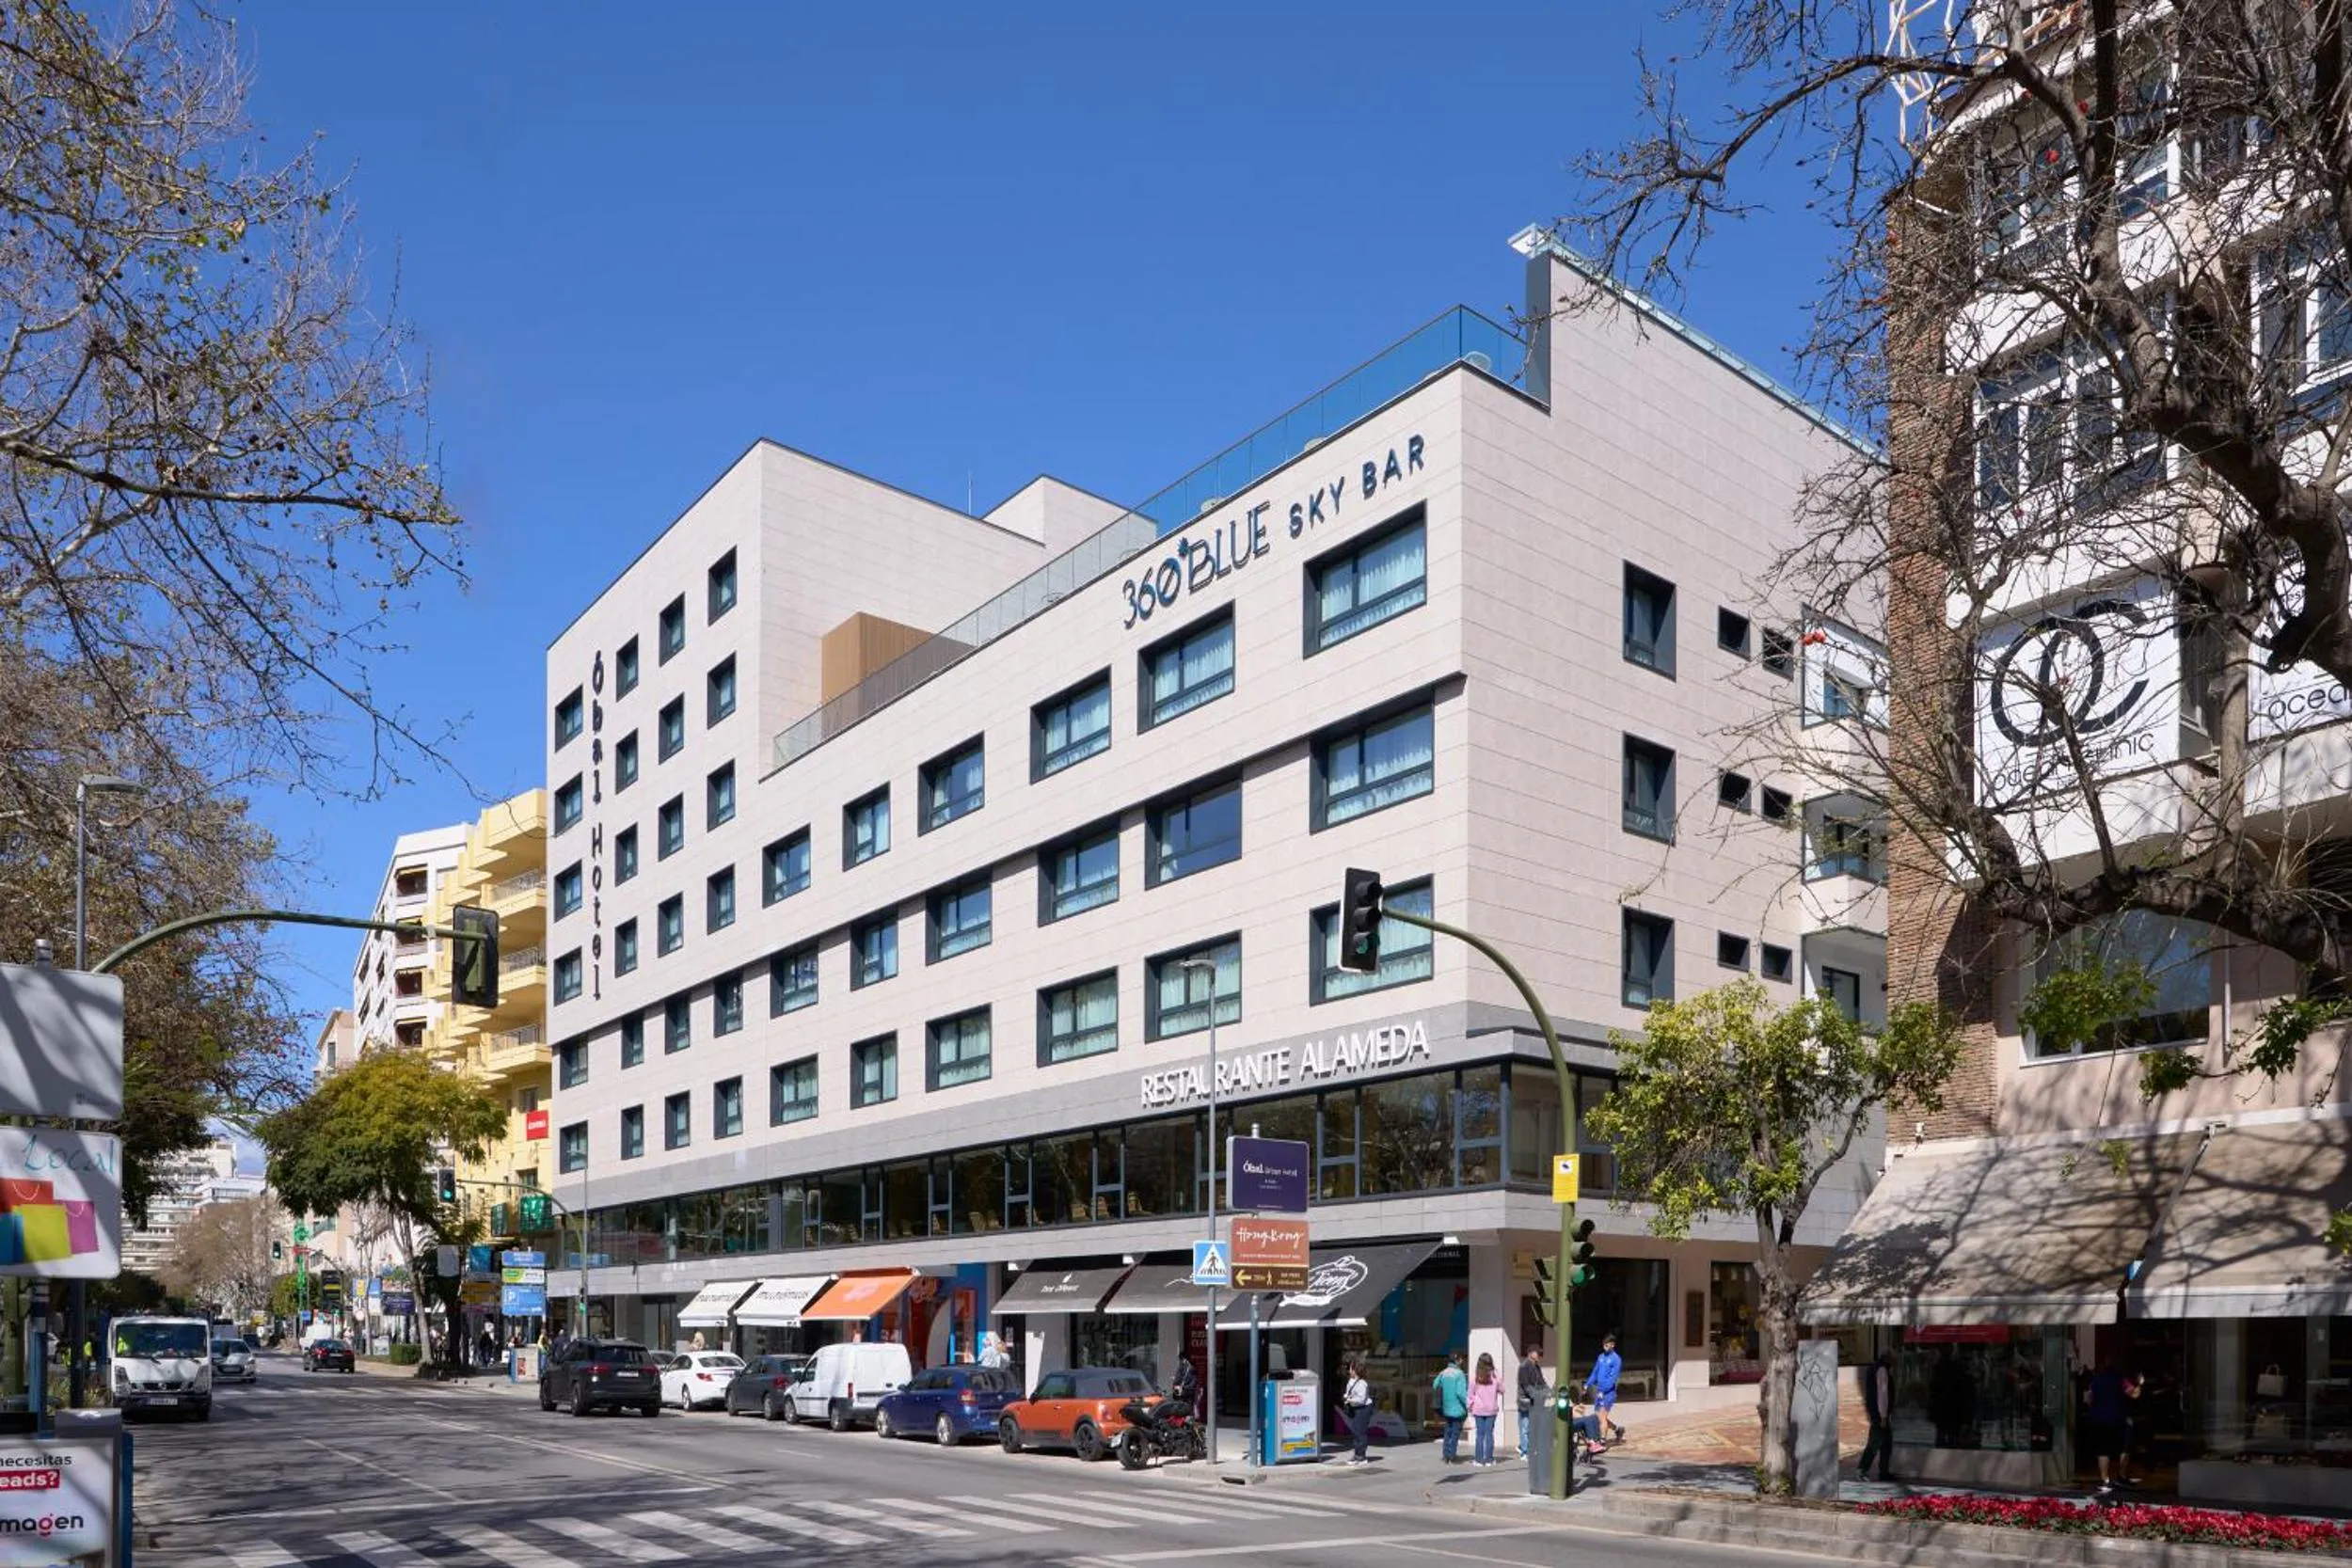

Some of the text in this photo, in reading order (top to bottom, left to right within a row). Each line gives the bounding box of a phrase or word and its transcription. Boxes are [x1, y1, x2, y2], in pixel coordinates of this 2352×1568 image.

[1289, 475, 1345, 540] SKY
[1362, 434, 1425, 500] BAR
[1140, 1020, 1430, 1105] RESTAURANTE ALAMEDA
[23, 1133, 114, 1175] Local
